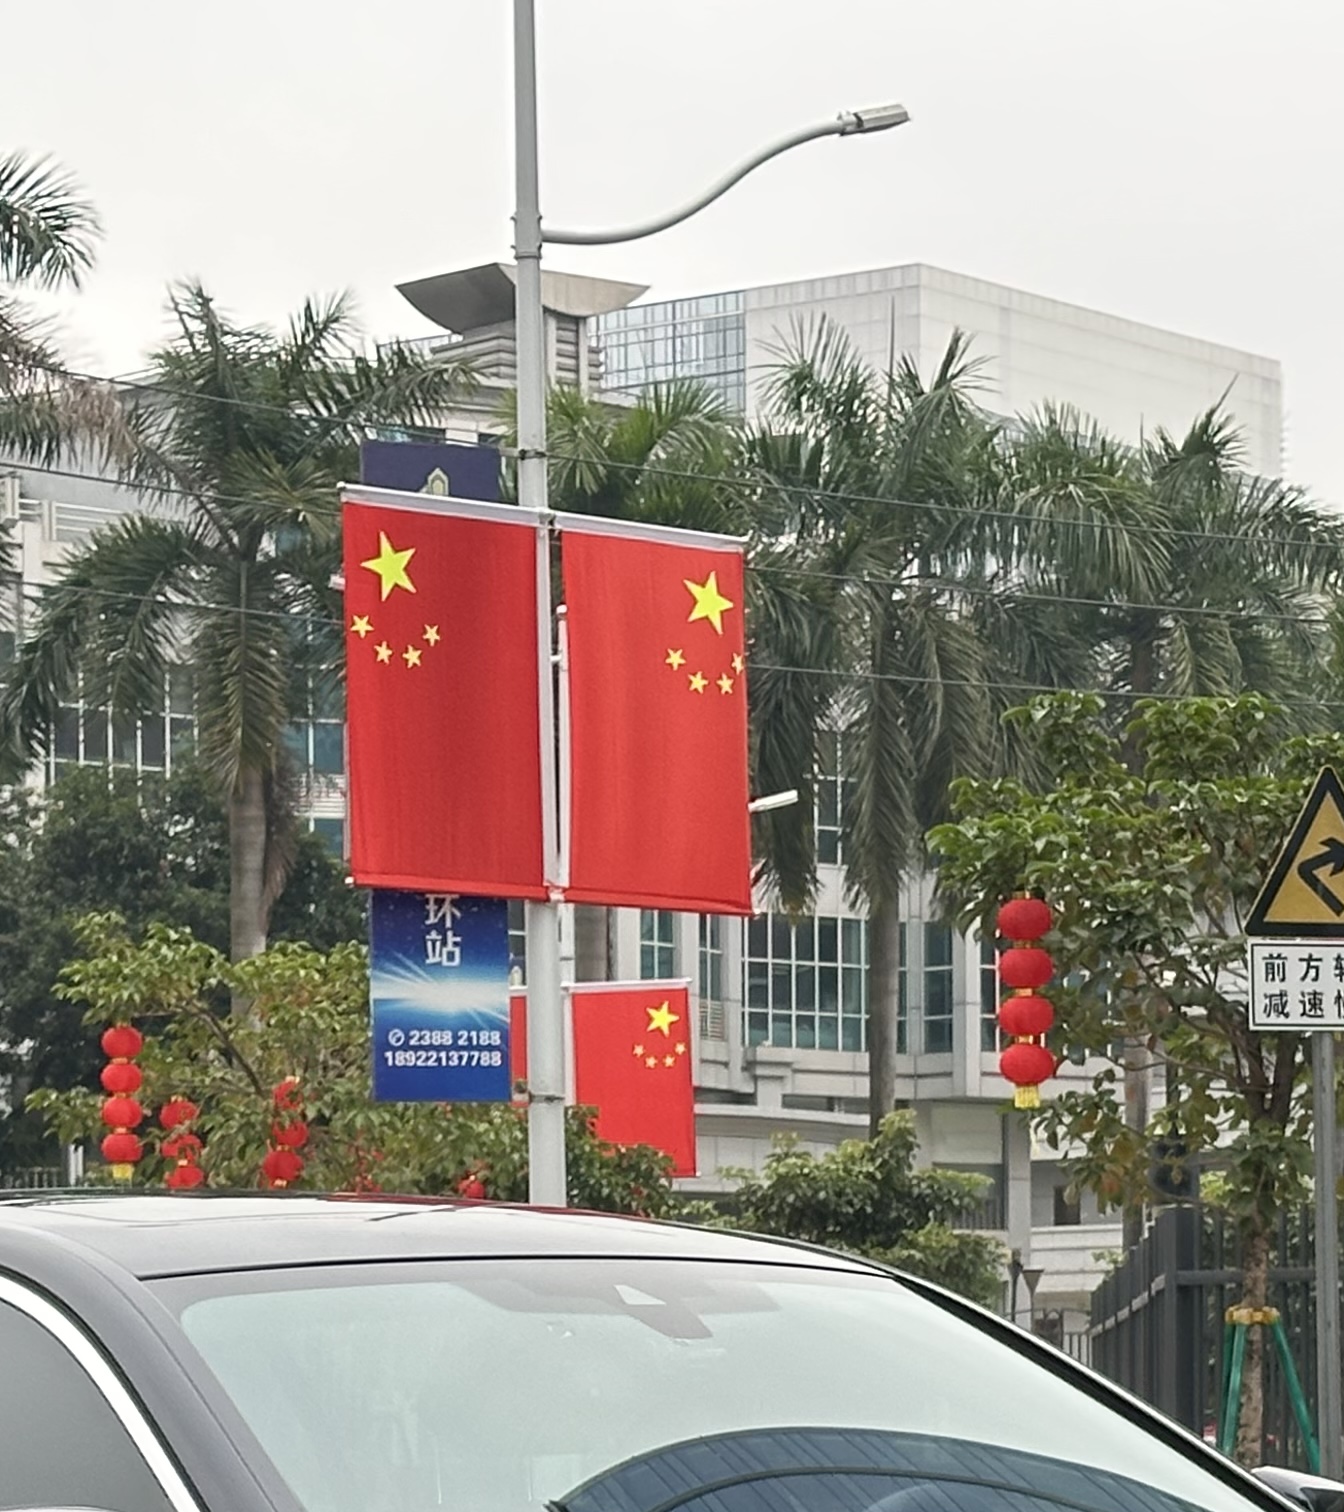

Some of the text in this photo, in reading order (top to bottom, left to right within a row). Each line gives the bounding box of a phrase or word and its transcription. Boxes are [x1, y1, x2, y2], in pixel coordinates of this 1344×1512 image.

[424, 893, 462, 967] 环站
[408, 1029, 501, 1046] 2388 2188
[384, 1050, 502, 1067] 18922137788
